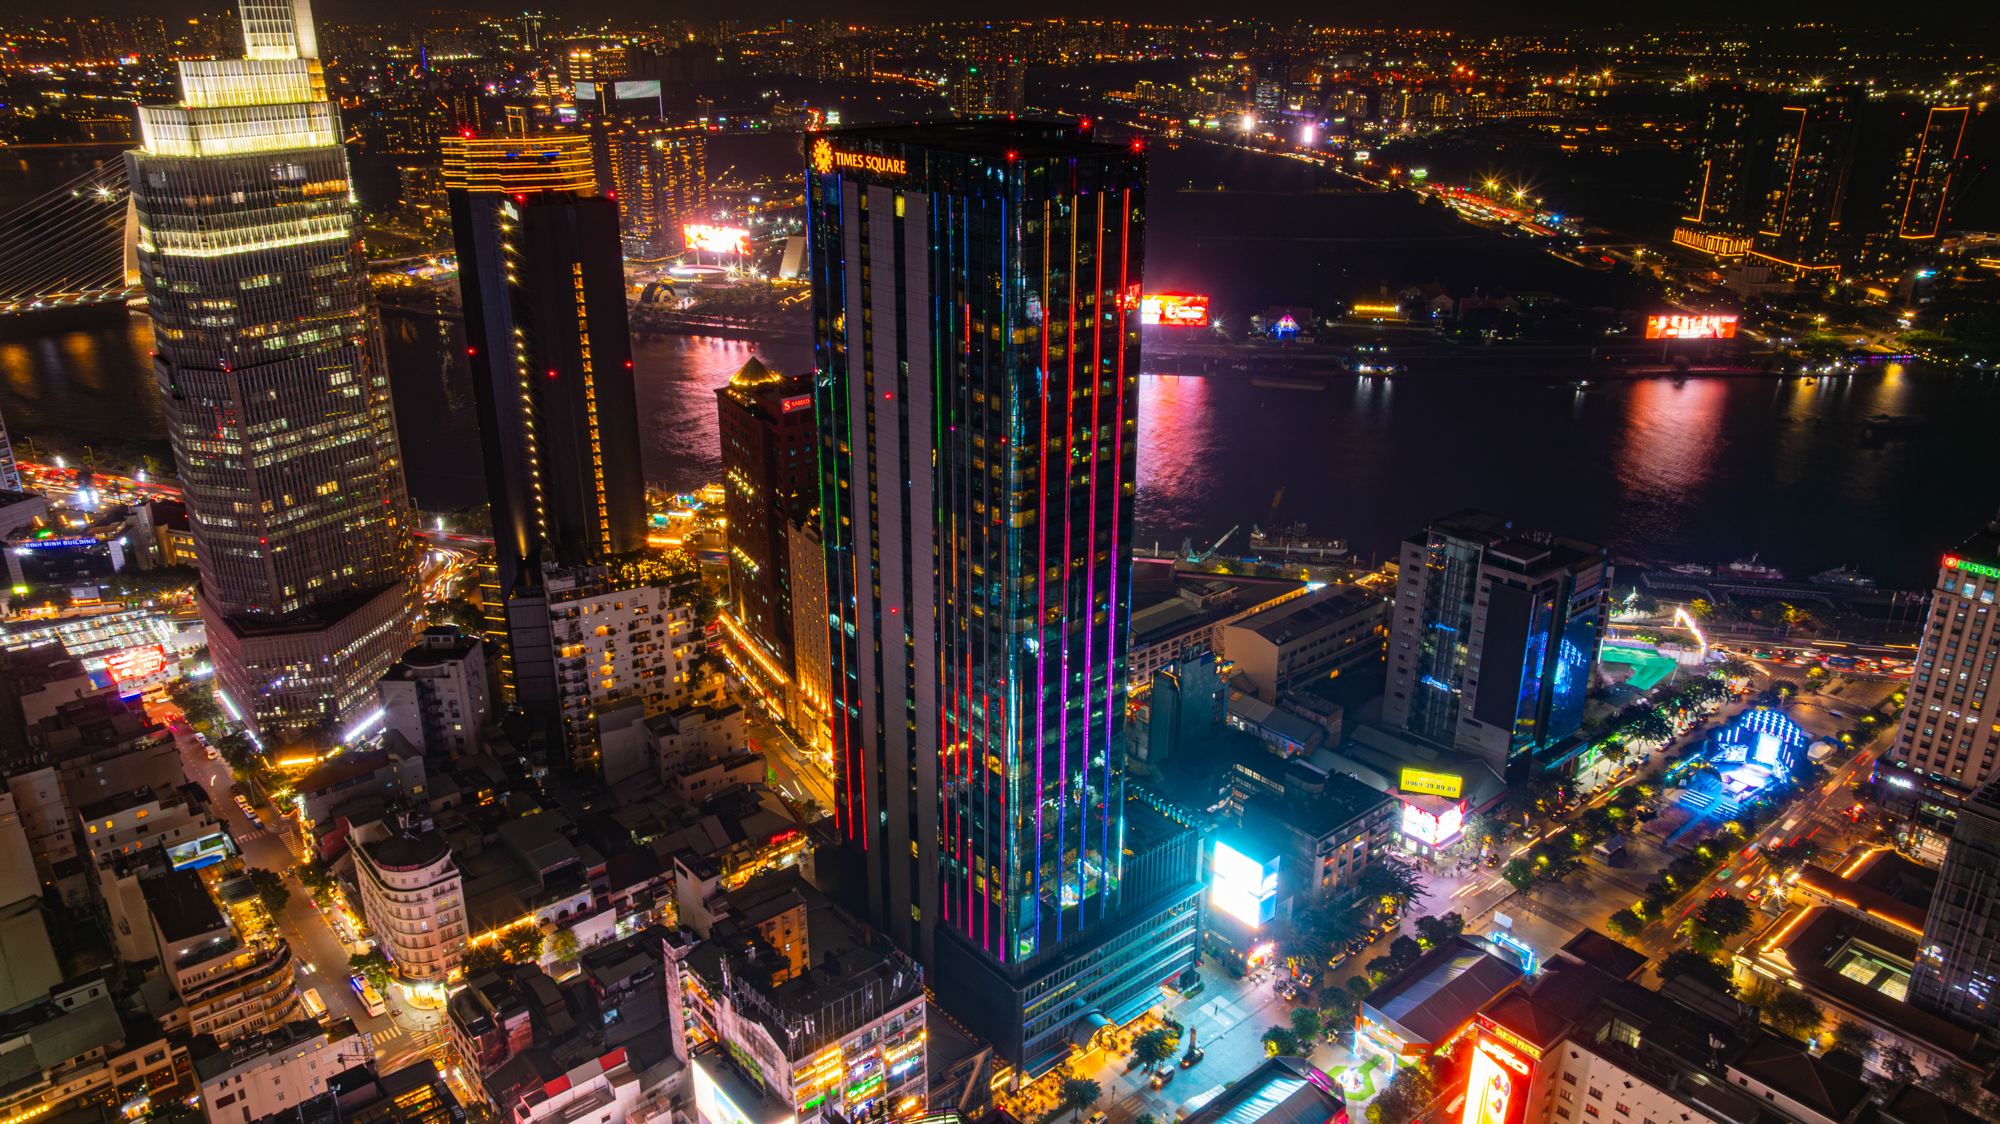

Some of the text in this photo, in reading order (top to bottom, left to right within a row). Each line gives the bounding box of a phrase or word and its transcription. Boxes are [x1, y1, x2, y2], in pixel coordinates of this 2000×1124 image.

[835, 152, 906, 174] TIMES SQUARE
[62, 538, 96, 546] BUILDING
[1495, 1027, 1517, 1046] SAIGON
[1517, 1041, 1540, 1059] PRINCE
